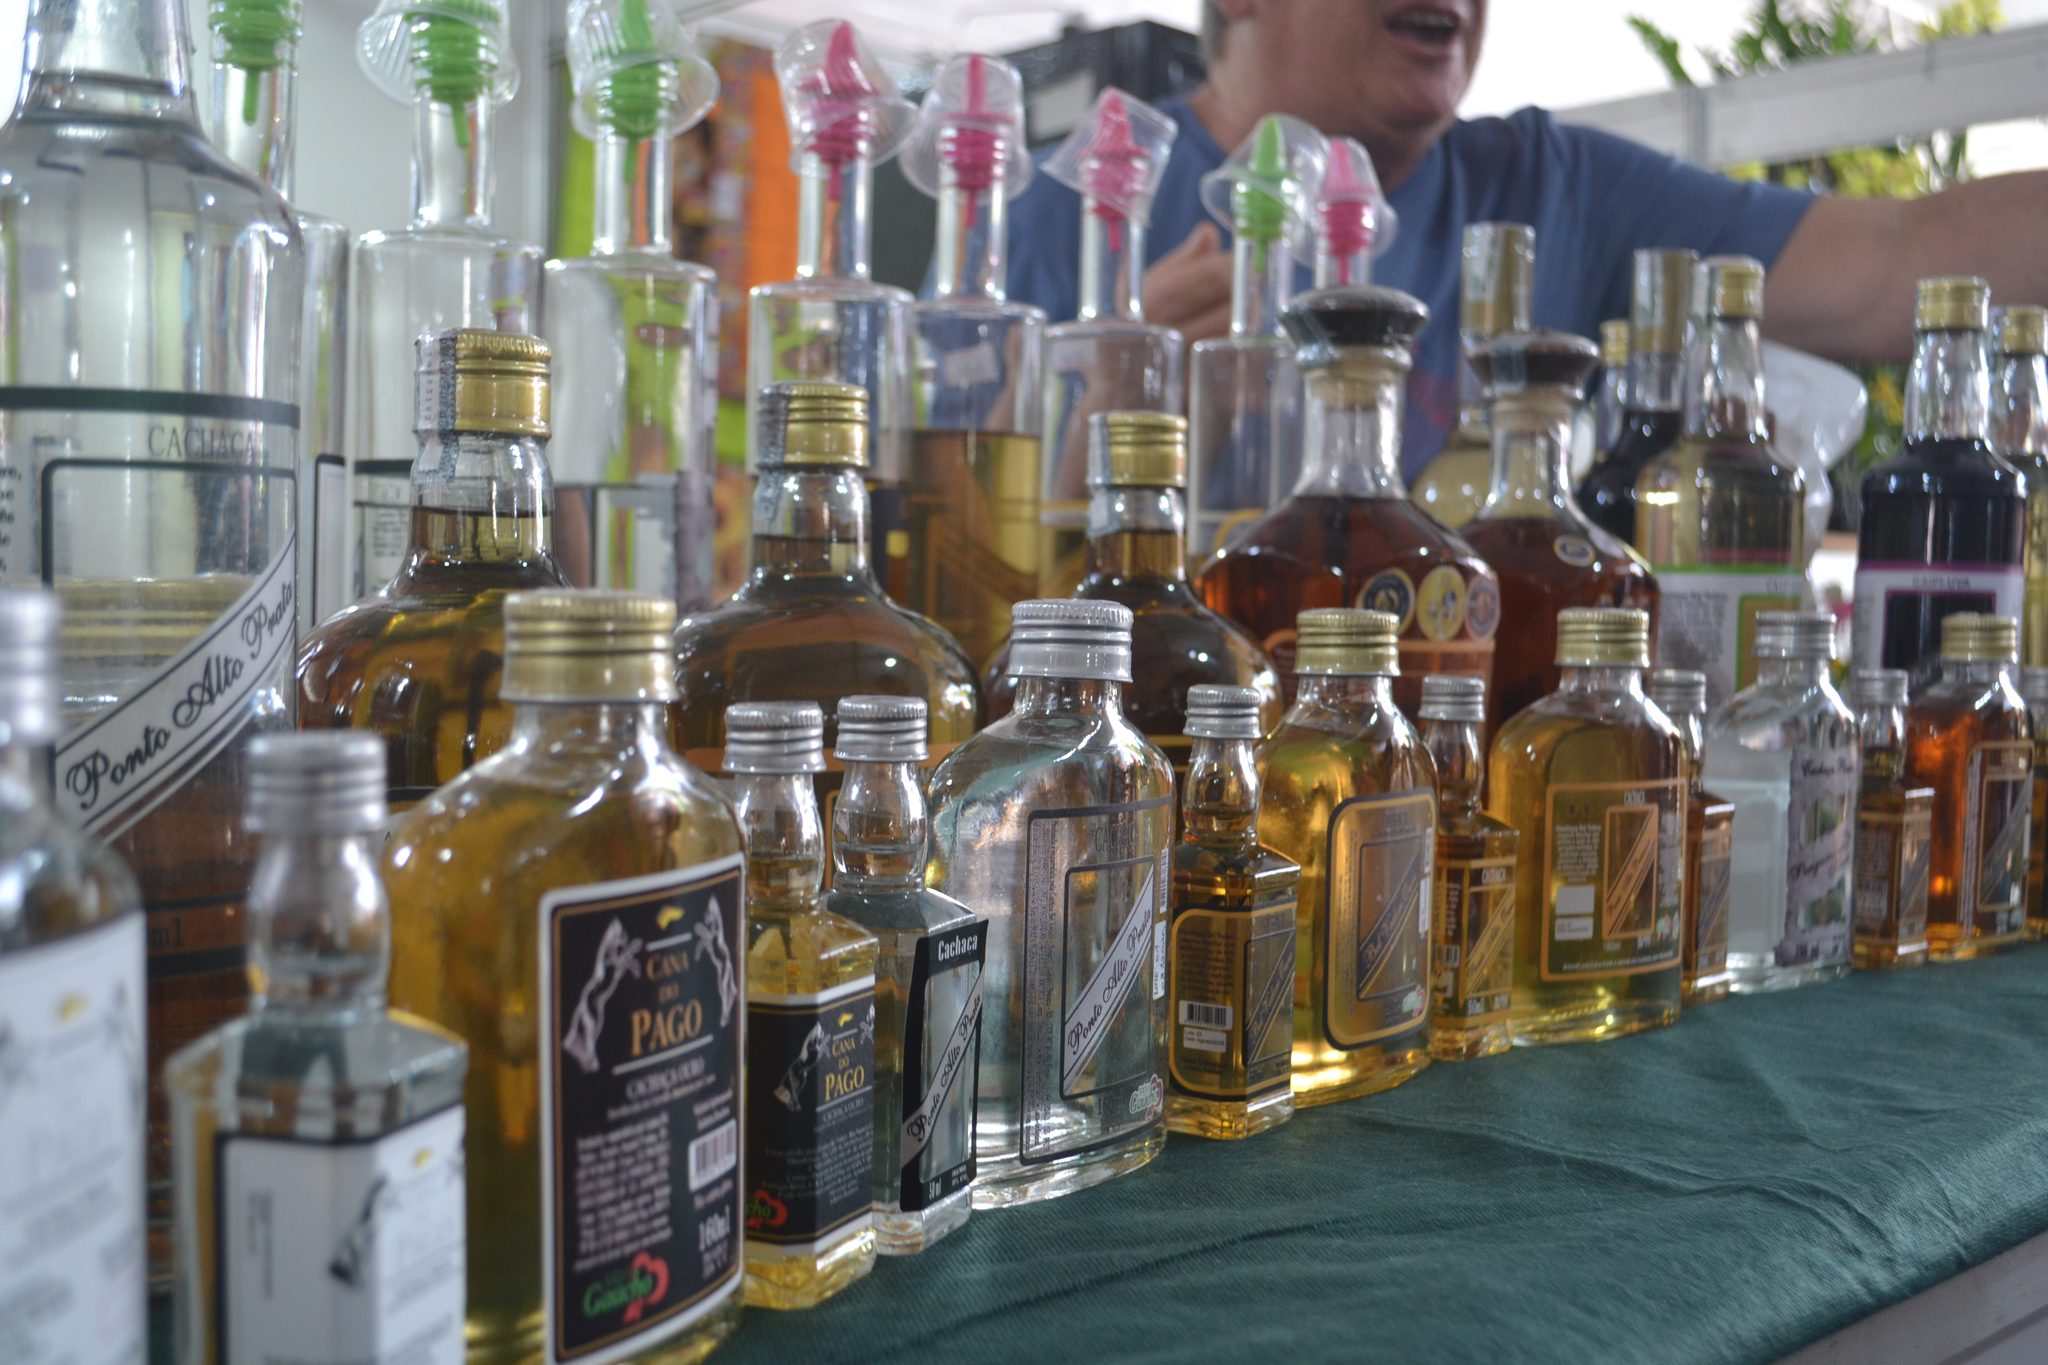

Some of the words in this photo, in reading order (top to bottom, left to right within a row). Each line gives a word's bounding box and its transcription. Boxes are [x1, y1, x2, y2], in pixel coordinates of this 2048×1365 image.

[65, 722, 172, 811] Ponto
[172, 654, 245, 730] Alto
[241, 580, 293, 660] Prata
[646, 950, 690, 981] CANA
[938, 933, 978, 962] Cachaça
[1067, 1004, 1103, 1056] Ponto
[1102, 959, 1129, 1004] Alto
[1126, 909, 1151, 960] Prata
[630, 997, 703, 1057] PAGO
[832, 1037, 857, 1057] CANA
[824, 1064, 865, 1104] PAGO
[906, 1093, 941, 1143] Ponto
[940, 1045, 961, 1088] Alto
